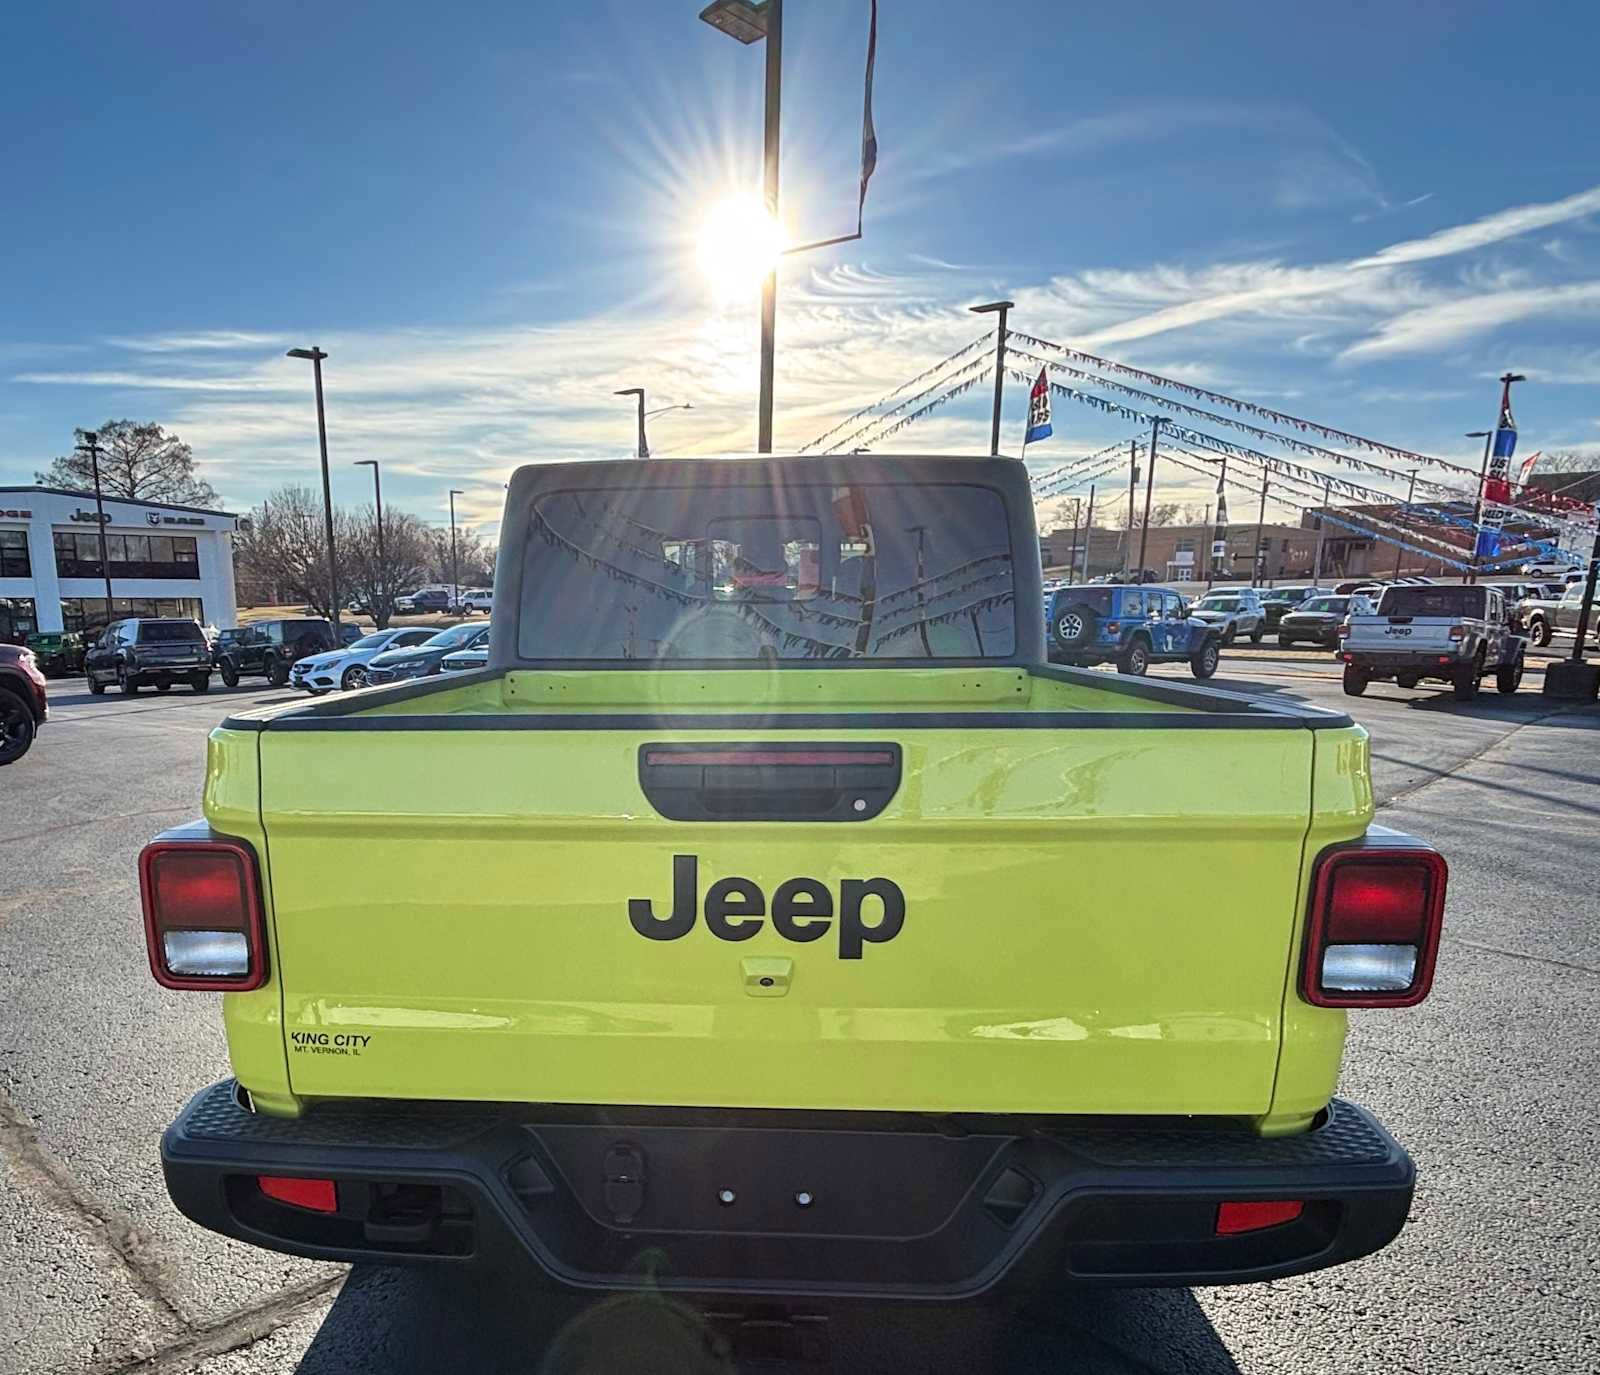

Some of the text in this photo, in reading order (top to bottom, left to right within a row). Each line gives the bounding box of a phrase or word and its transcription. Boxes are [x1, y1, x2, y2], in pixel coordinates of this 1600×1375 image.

[1384, 626, 1412, 636] Jeep
[628, 854, 906, 960] Jeep
[291, 1031, 371, 1047] KING CITY
[352, 1048, 361, 1056] IL
